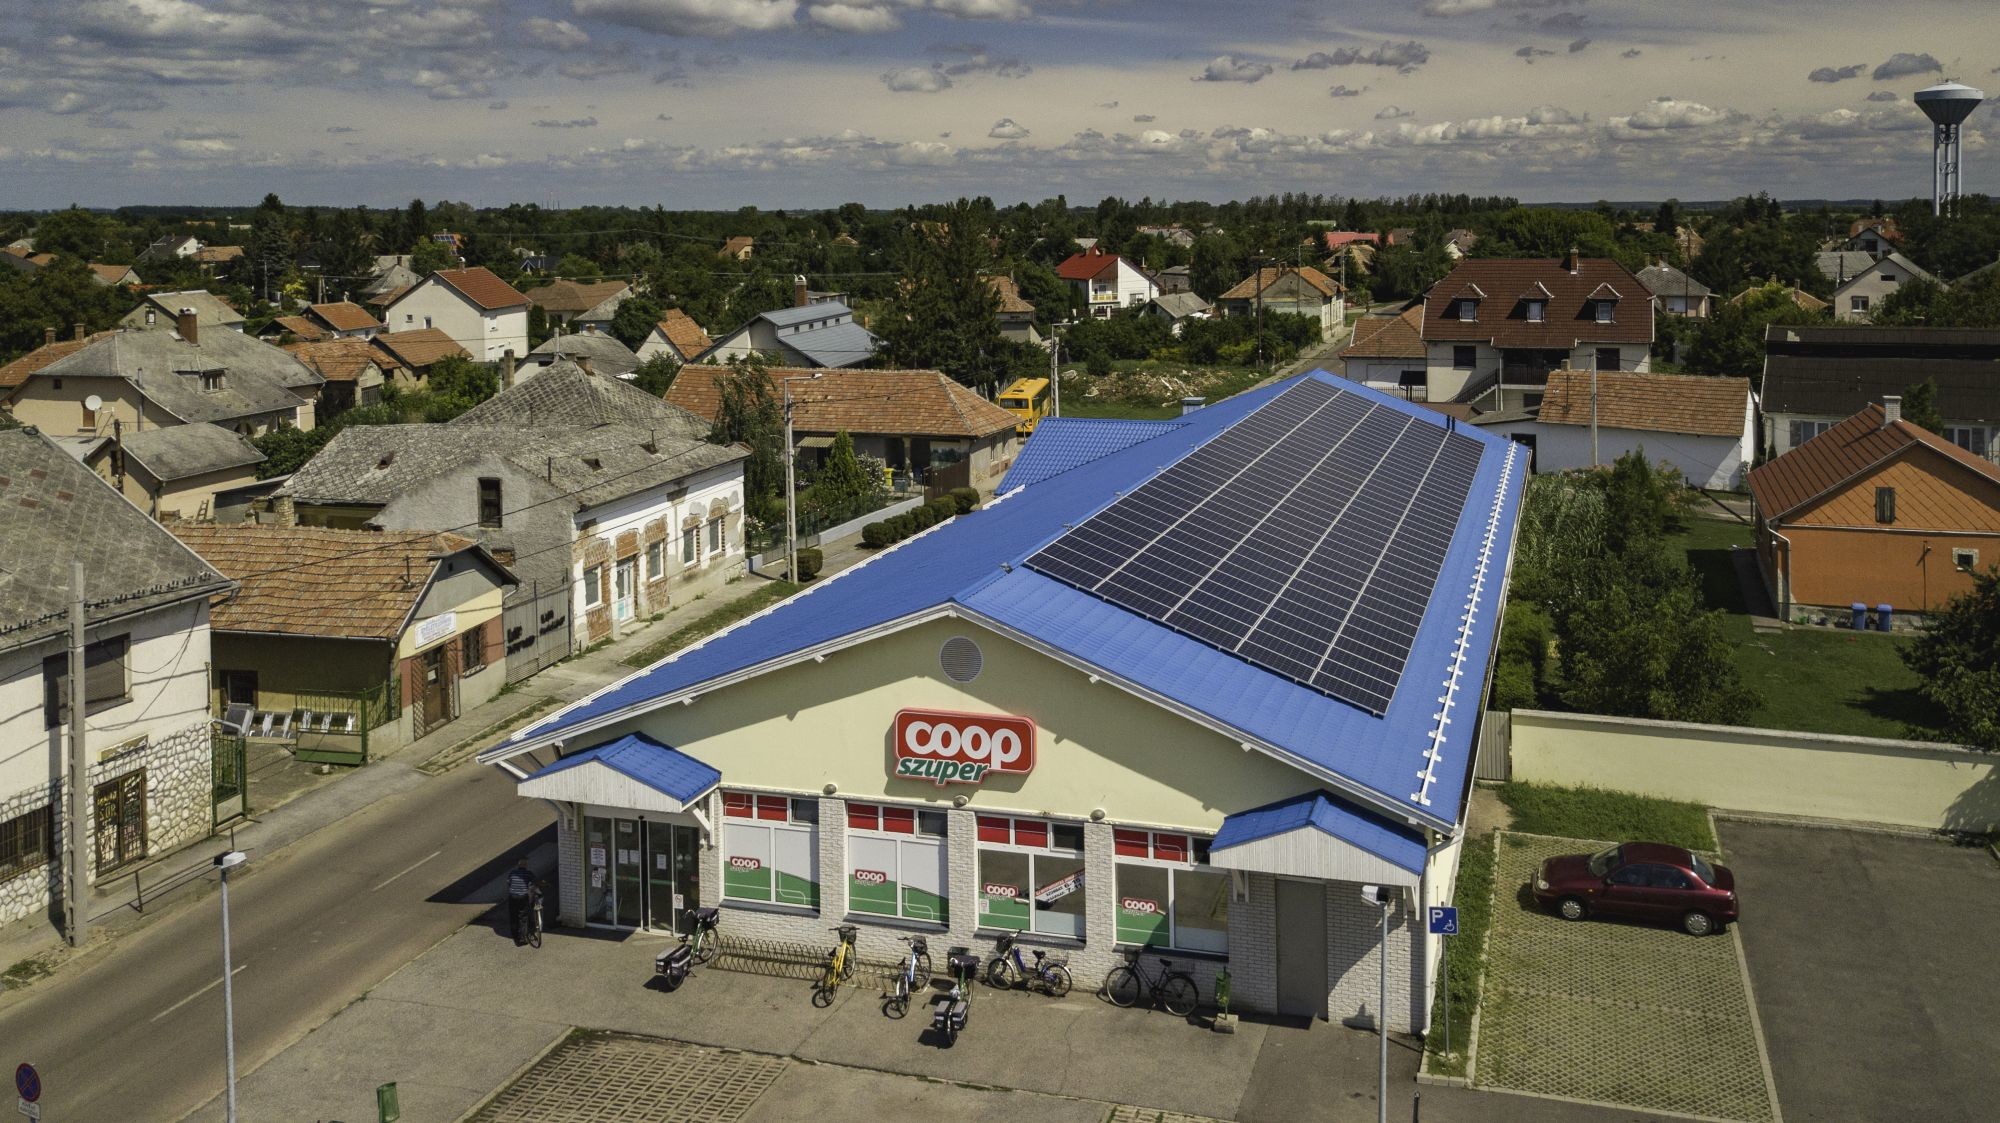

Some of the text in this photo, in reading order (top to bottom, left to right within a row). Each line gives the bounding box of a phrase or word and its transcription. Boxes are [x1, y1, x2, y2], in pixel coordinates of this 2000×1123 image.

[905, 721, 1022, 770] coop
[897, 758, 989, 785] szuper
[732, 857, 759, 869] coop
[857, 871, 885, 883] coop
[986, 885, 1016, 898] coop
[1124, 900, 1155, 913] coop
[1432, 910, 1444, 923] P
